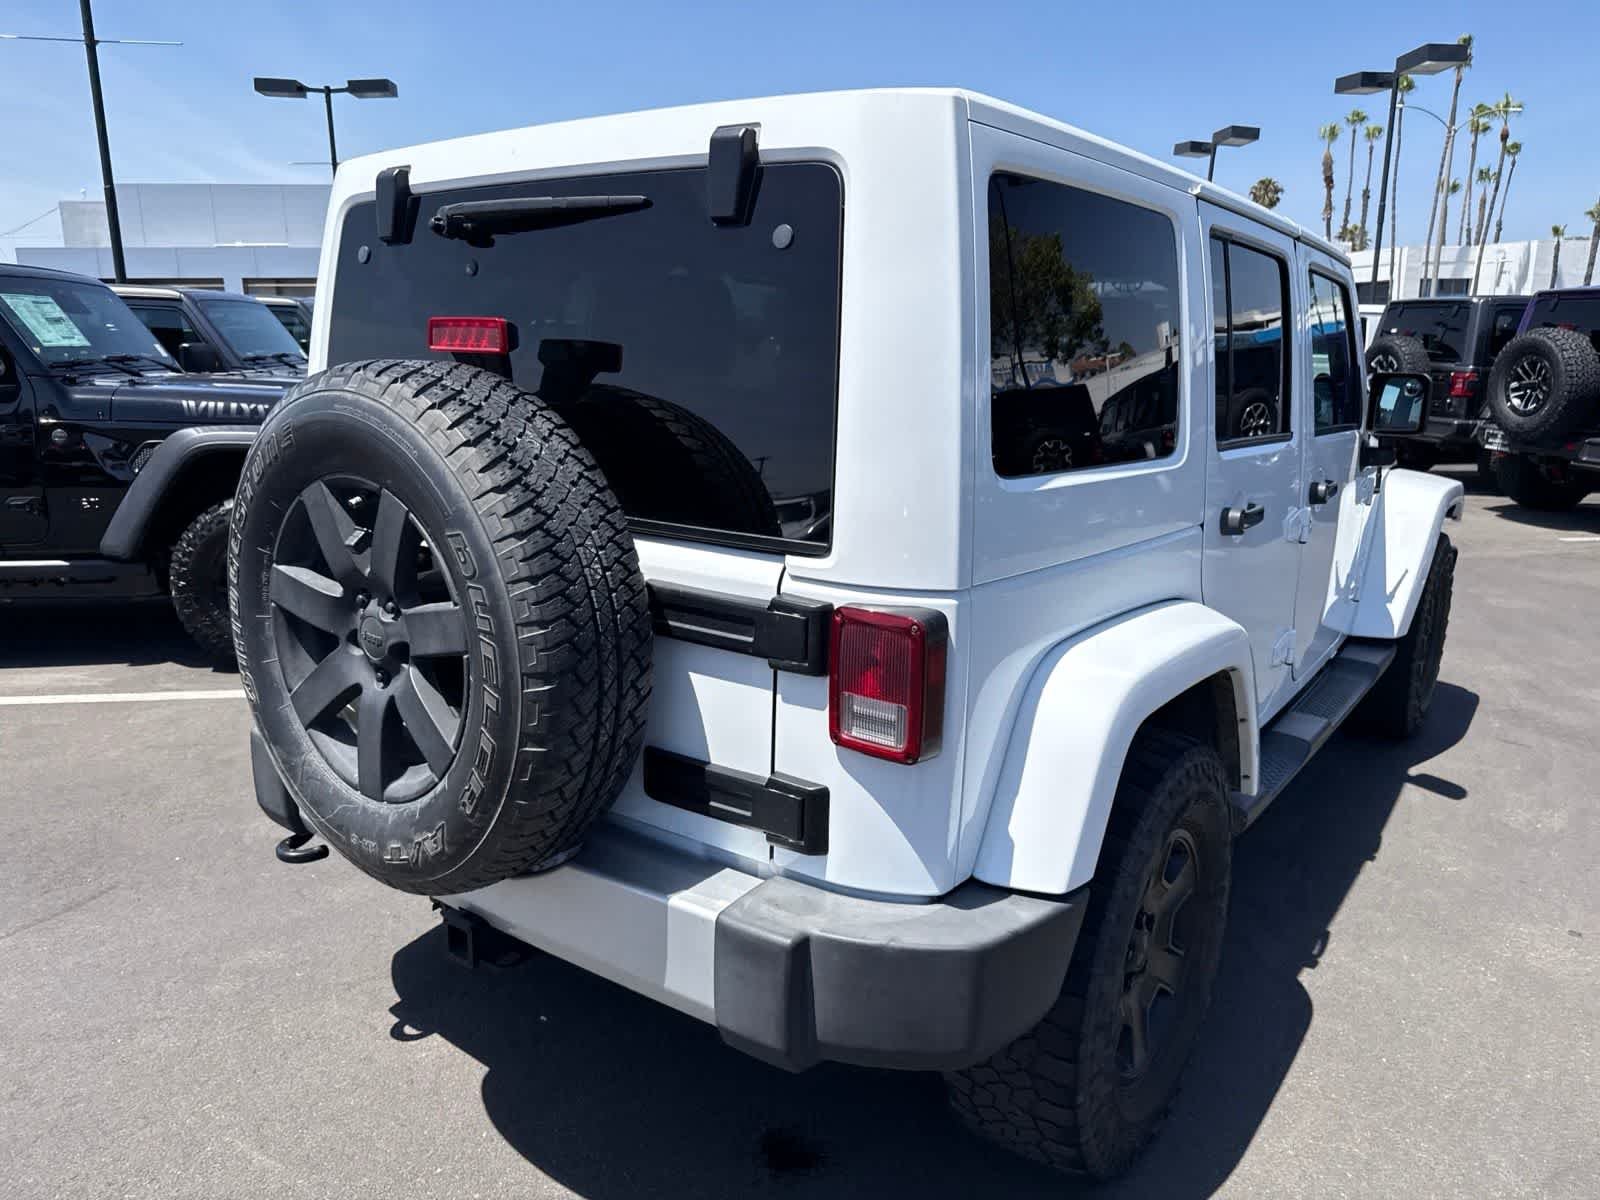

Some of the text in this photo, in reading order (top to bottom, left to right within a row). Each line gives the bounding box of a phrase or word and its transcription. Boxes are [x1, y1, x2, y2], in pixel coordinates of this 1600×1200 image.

[229, 418, 296, 705] BRIDGESTONE
[383, 531, 501, 868] DUELER A/T
